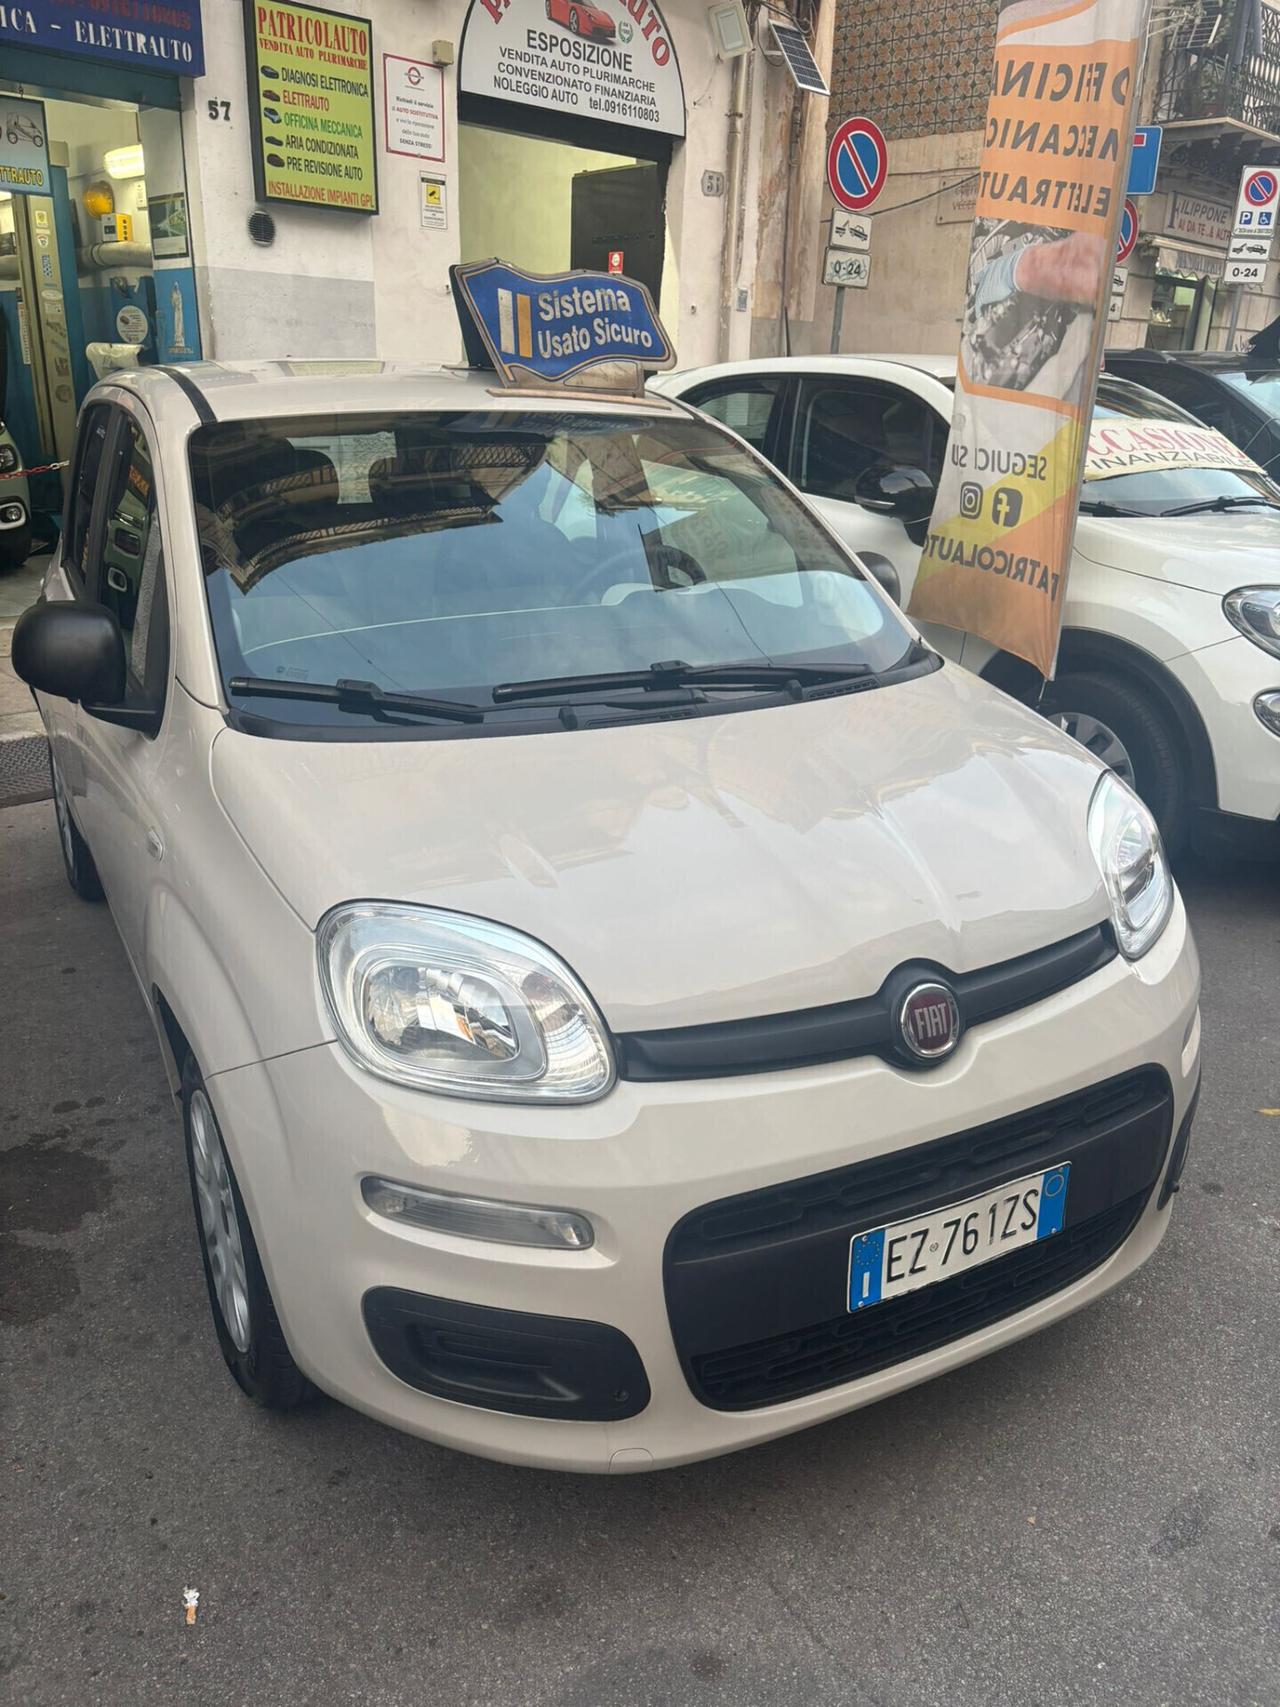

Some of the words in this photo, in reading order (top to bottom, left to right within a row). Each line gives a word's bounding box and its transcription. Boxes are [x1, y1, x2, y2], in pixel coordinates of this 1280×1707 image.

[75, 20, 193, 63] ELETTRAUTO
[257, 6, 367, 56] PATRICOLAUTO
[259, 38, 293, 55] VENDITA
[295, 46, 315, 59] AUTO
[526, 29, 633, 73] ESPOSIZIONE
[281, 67, 318, 88] DIAGNOSI
[320, 76, 369, 97] ELETTRONICA
[499, 46, 548, 68] VENDITA
[550, 58, 580, 75] AUTO
[583, 66, 656, 93] PLURIMARCHE
[493, 75, 549, 99] NOLEGGIO
[551, 89, 579, 106] AUTO
[589, 96, 660, 123] tel.0916110803
[497, 62, 592, 93] CONVENZIONATO
[594, 84, 657, 108] FINANZIARIA
[207, 100, 231, 121] 57
[283, 90, 330, 112] ELETTRAUTO
[284, 112, 319, 132] OFFICINA
[320, 120, 363, 138] MECCANICA
[285, 135, 305, 150] ARIA
[305, 138, 359, 159] CONDIZIONATA
[286, 156, 302, 171] PRE
[304, 160, 342, 178] REVISIONE
[344, 166, 363, 180] AUTO
[268, 180, 326, 201] INSTALLAZIONE
[327, 188, 359, 205] IMPIANTI
[360, 193, 374, 208] GPL
[833, 260, 861, 276] 0-24
[1232, 267, 1258, 278] 0-24
[537, 286, 631, 321] Sistema
[537, 327, 591, 359] Usato
[593, 317, 653, 348] Sicuro
[1085, 451, 1256, 471] INANZIABILE
[914, 1002, 948, 1040] FIAT
[886, 1227, 930, 1284] EZ
[941, 1188, 1039, 1267] 761ZS
